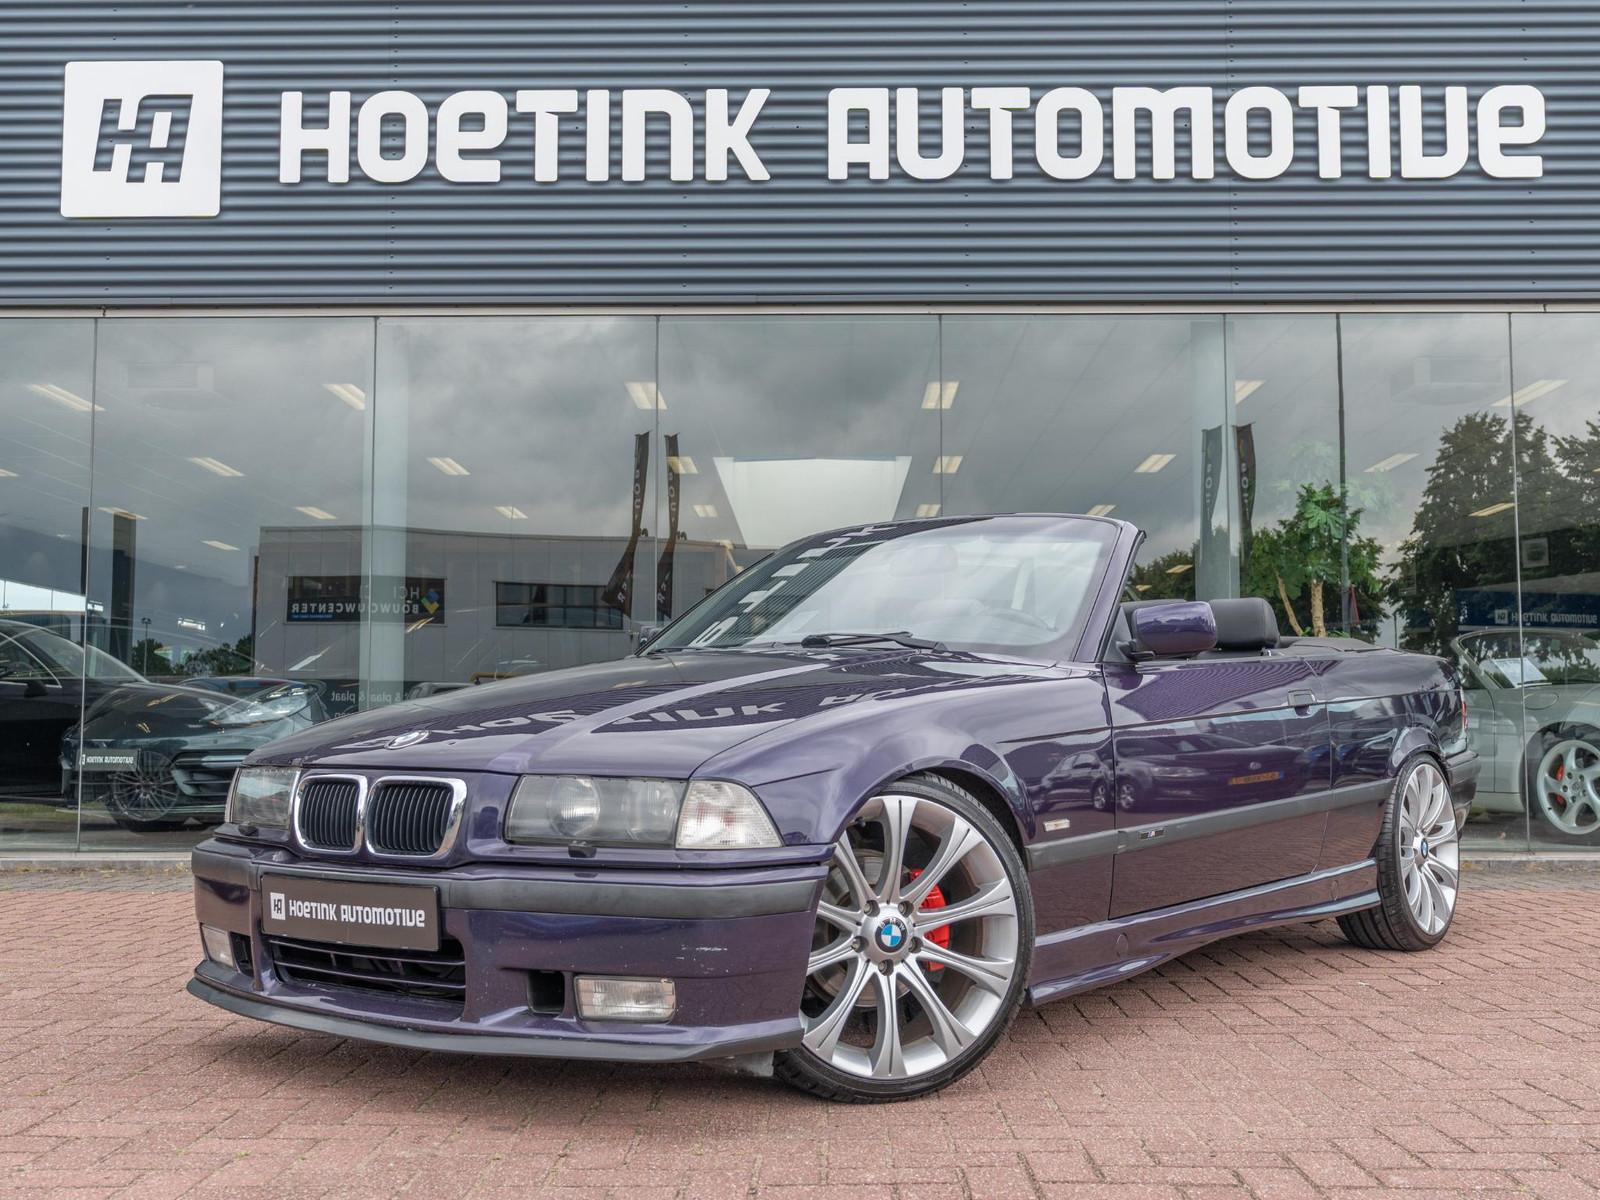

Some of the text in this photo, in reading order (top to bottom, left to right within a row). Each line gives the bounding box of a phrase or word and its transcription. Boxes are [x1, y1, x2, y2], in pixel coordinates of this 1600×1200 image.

[279, 88, 770, 184] HOETINK
[827, 84, 1546, 182] AUTOMOTIVE
[1512, 612, 1548, 622] HETINK
[1551, 613, 1598, 624] AUTOMOTIVE
[289, 900, 337, 921] HOETINK
[341, 905, 425, 927] AUTOMOTIVE
